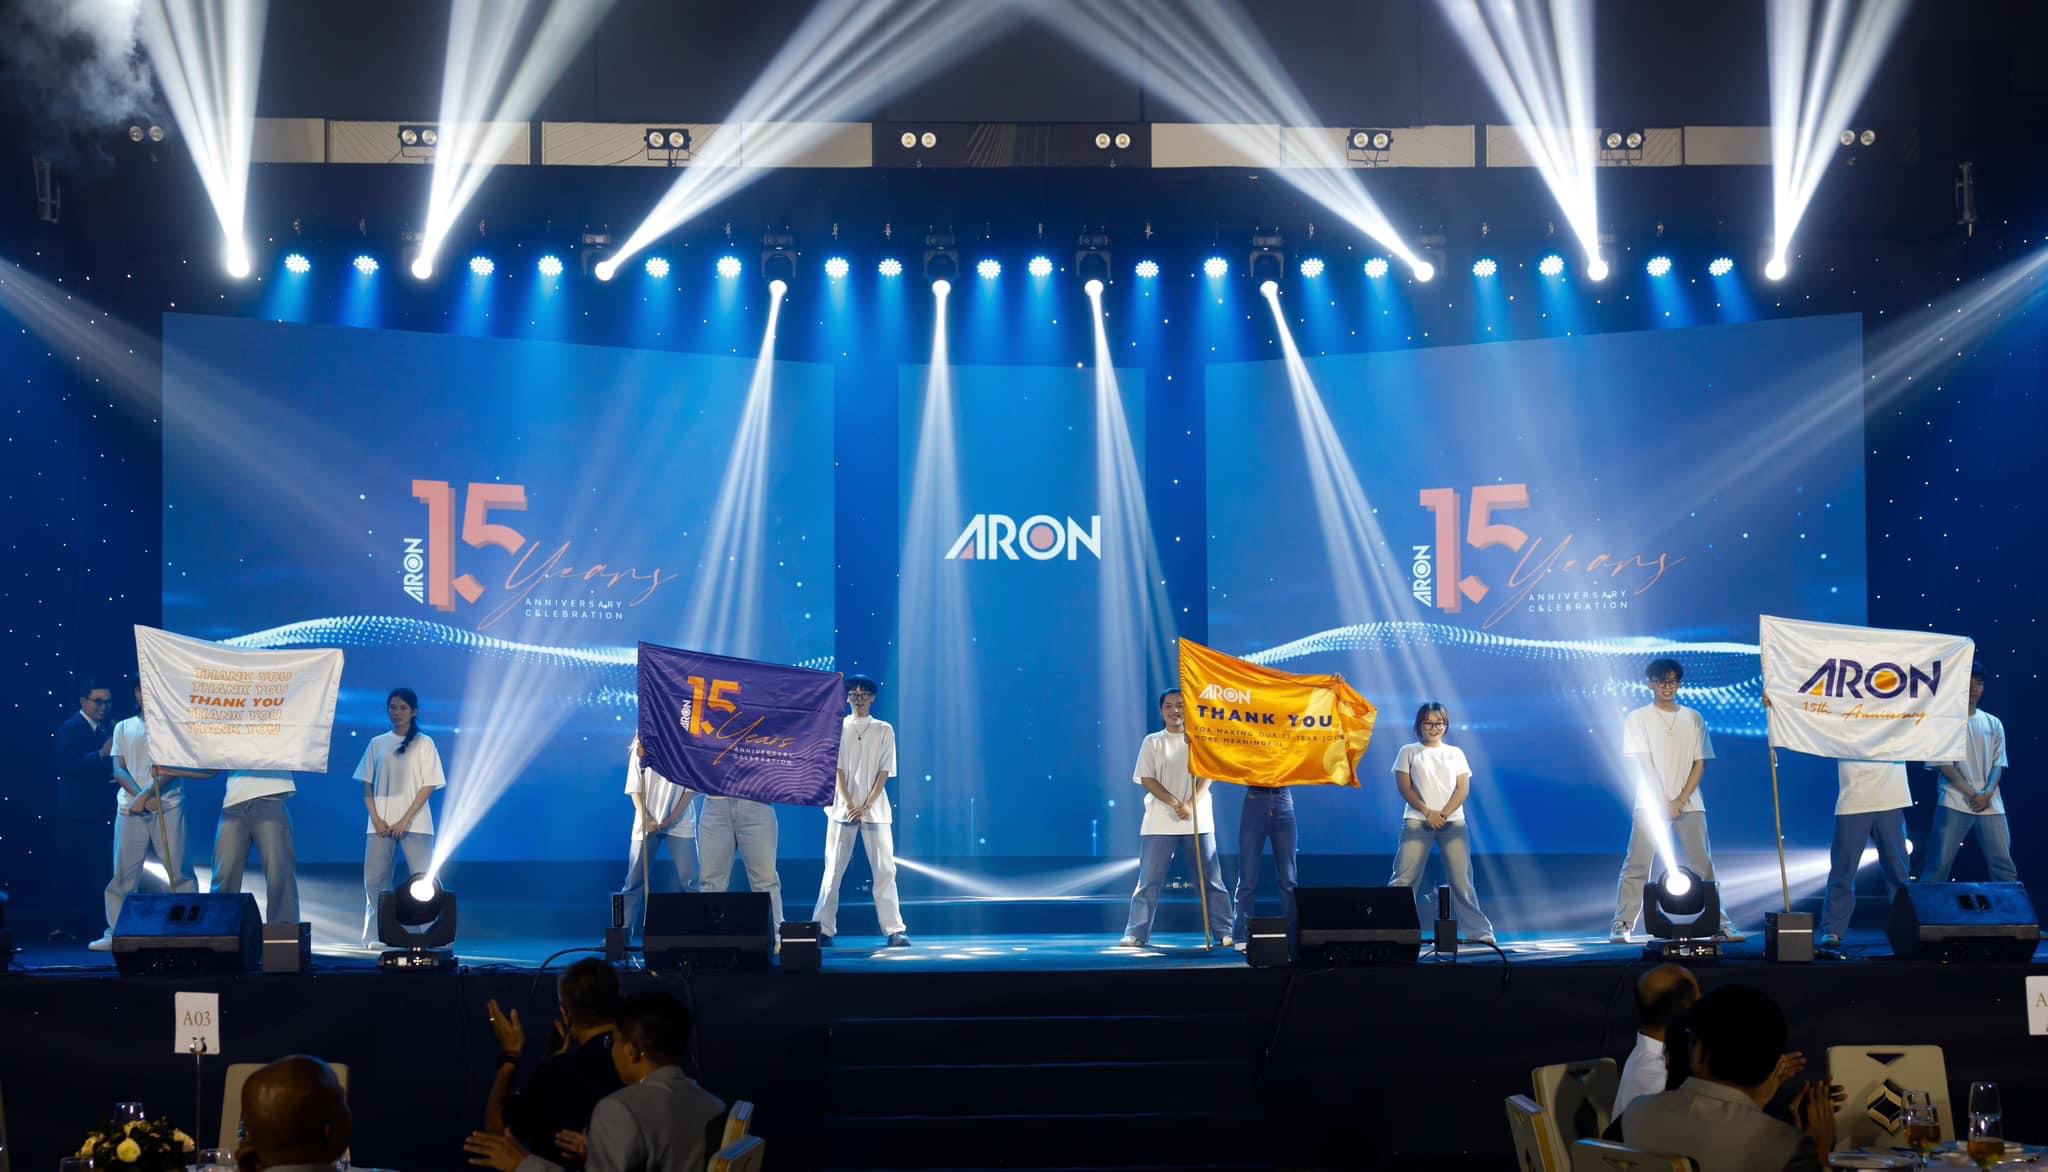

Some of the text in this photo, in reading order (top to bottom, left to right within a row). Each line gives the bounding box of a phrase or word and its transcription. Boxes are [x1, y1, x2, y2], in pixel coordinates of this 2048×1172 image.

[412, 479, 528, 612] 15
[944, 513, 1102, 561] ARON
[1420, 483, 1529, 613] 15
[403, 537, 424, 604] ARON
[1412, 544, 1431, 608] ARON
[476, 540, 678, 631] Years
[1482, 533, 1687, 629] Years
[525, 598, 623, 609] ANNIVERSARY
[1528, 589, 1628, 601] ANNIVERSARY
[525, 608, 624, 620] CELEBRATION
[1528, 601, 1629, 613] CELEBRATION
[195, 667, 292, 683] THANK YOU
[1798, 658, 1942, 699] ARON
[192, 681, 289, 696] THANK YOU
[1199, 683, 1251, 705] ARON
[190, 694, 284, 707] THANK YOU
[688, 676, 742, 738] 15
[1803, 701, 1832, 715] 15th
[187, 707, 282, 721] THANK YOU
[680, 699, 691, 732] ARON
[1197, 704, 1333, 728] THANK YOU
[184, 721, 280, 735] THANK YOU
[1216, 728, 1254, 738] MAKING
[183, 1010, 211, 1026] A03
